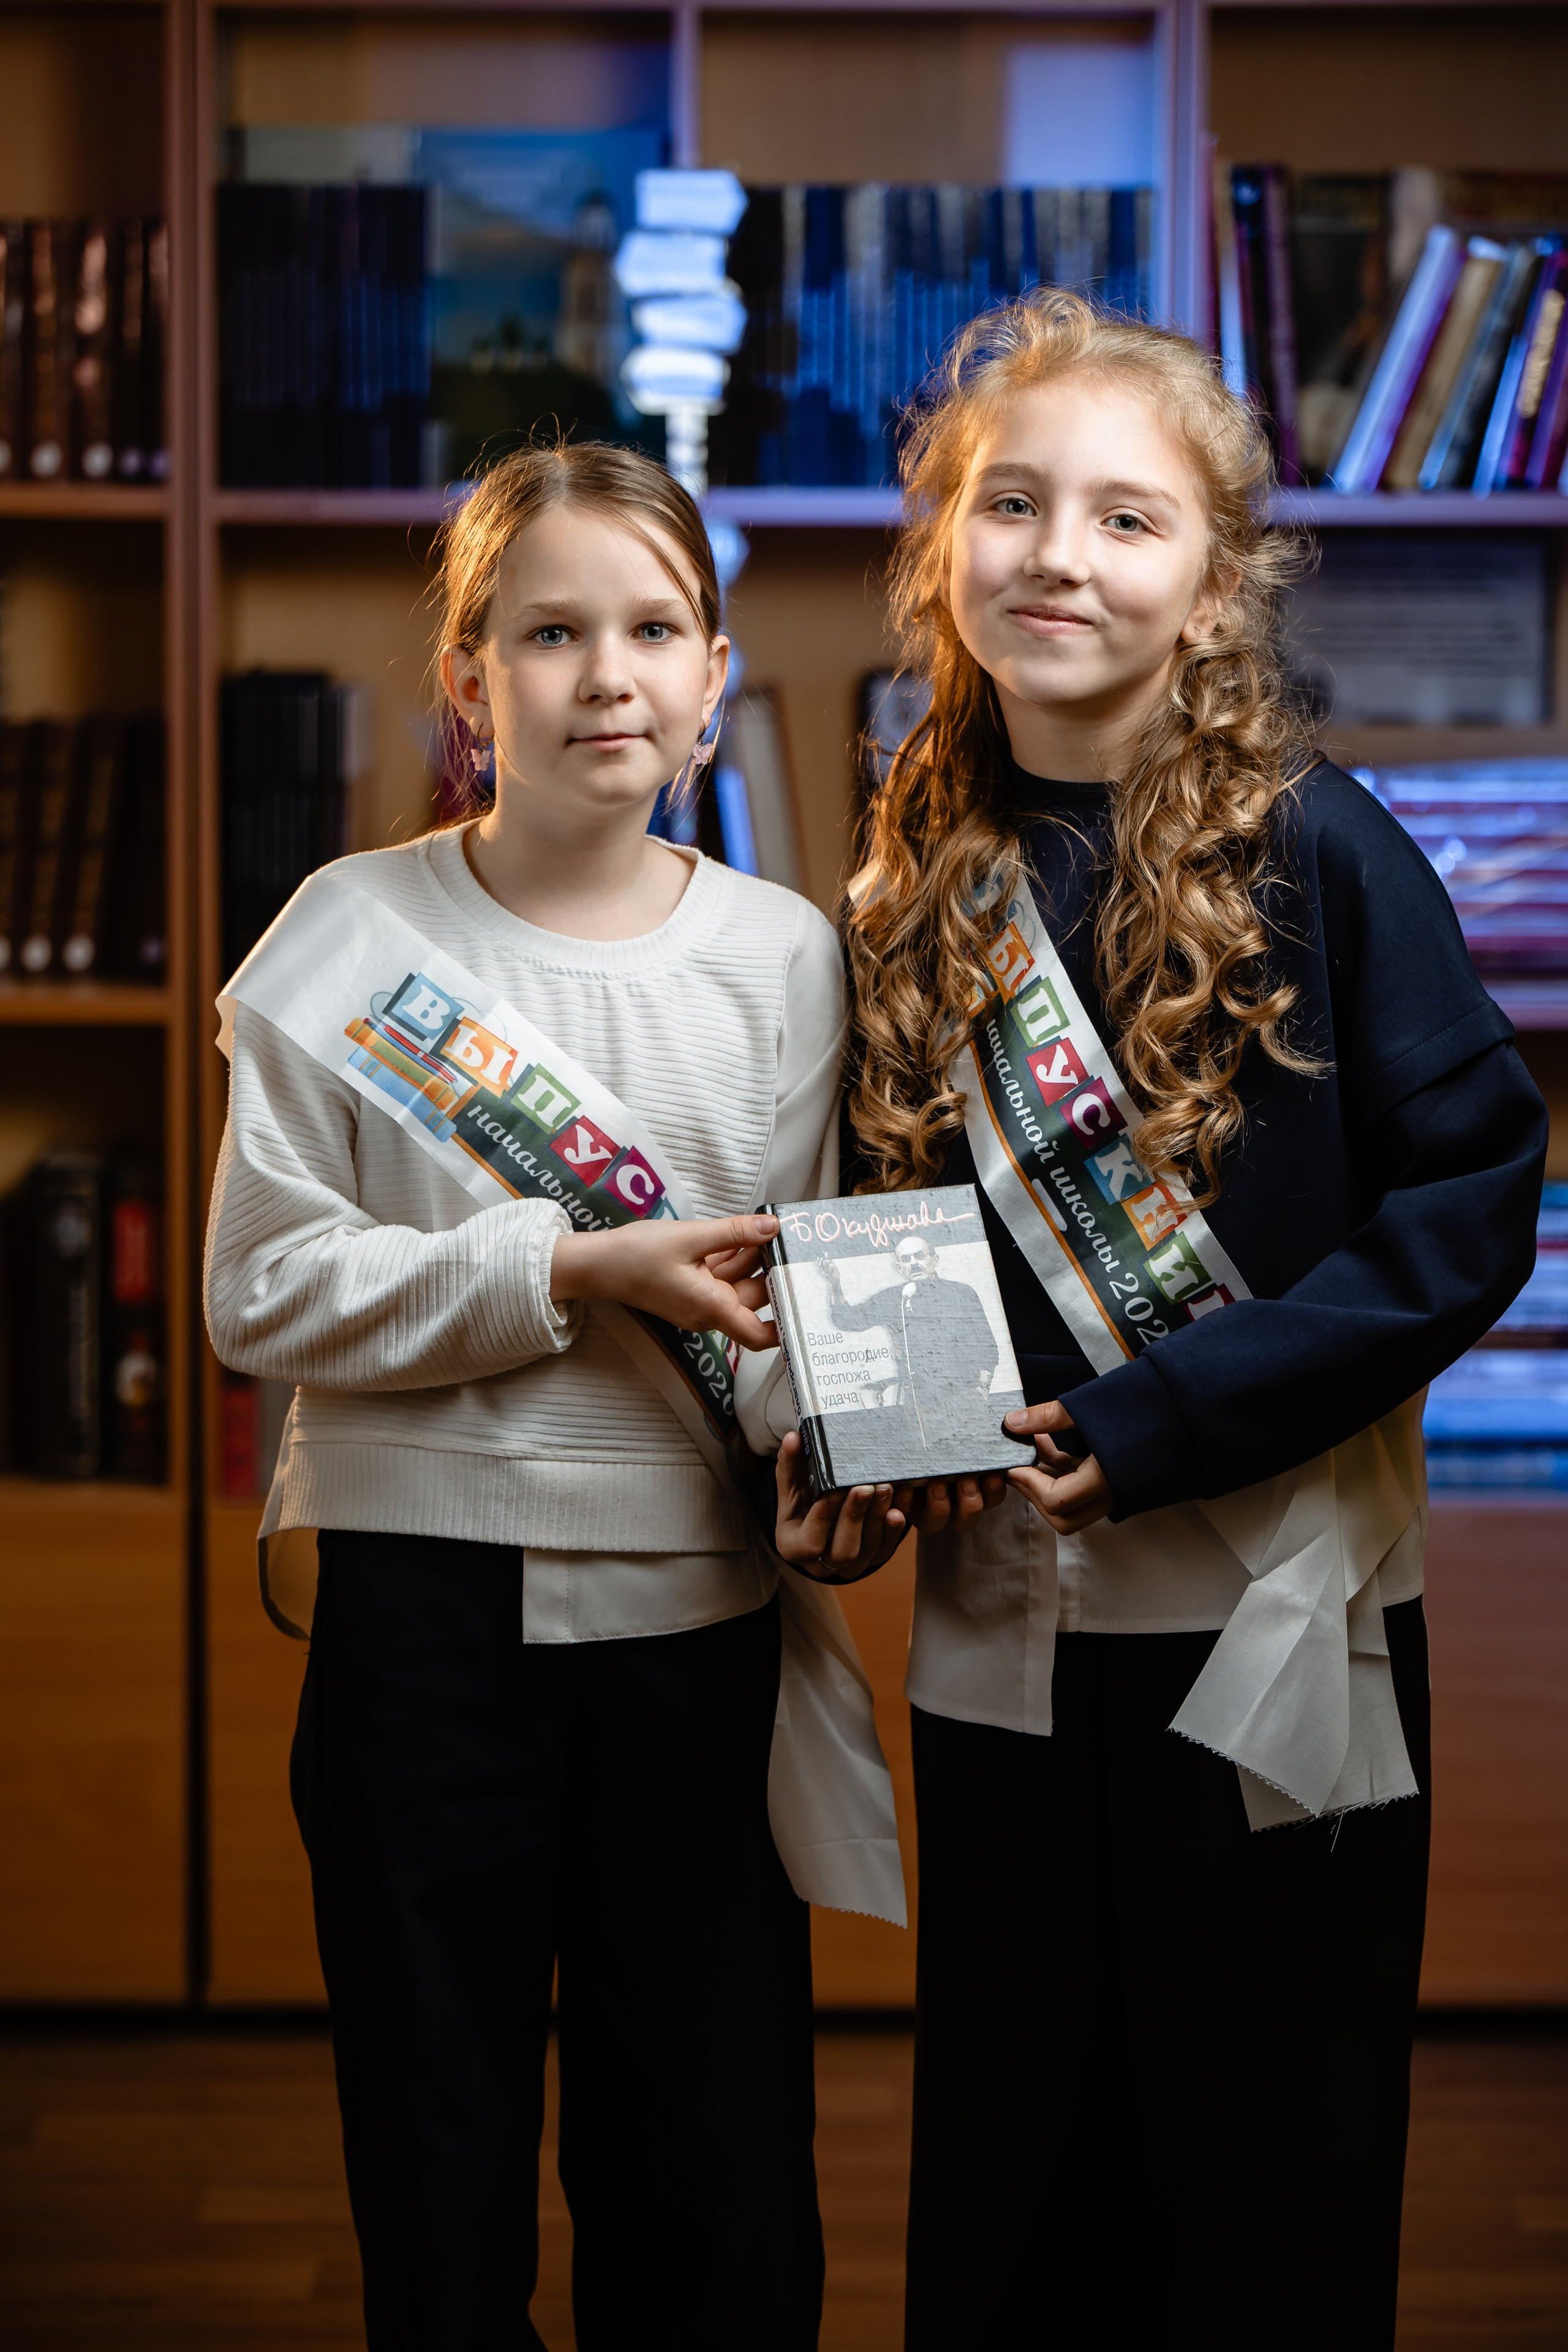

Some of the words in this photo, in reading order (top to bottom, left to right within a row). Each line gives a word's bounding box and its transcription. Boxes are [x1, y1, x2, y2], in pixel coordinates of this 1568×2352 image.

[402, 984, 675, 1220] ВЫПУС
[976, 882, 1225, 1321] ЫПУСКНИ
[1050, 1167, 1120, 1273] школы
[1109, 1272, 1169, 1345] 202
[807, 1332, 843, 1346] Ваше
[812, 1348, 889, 1366] благородие
[817, 1370, 871, 1386] госпожа
[821, 1392, 859, 1409] удача
